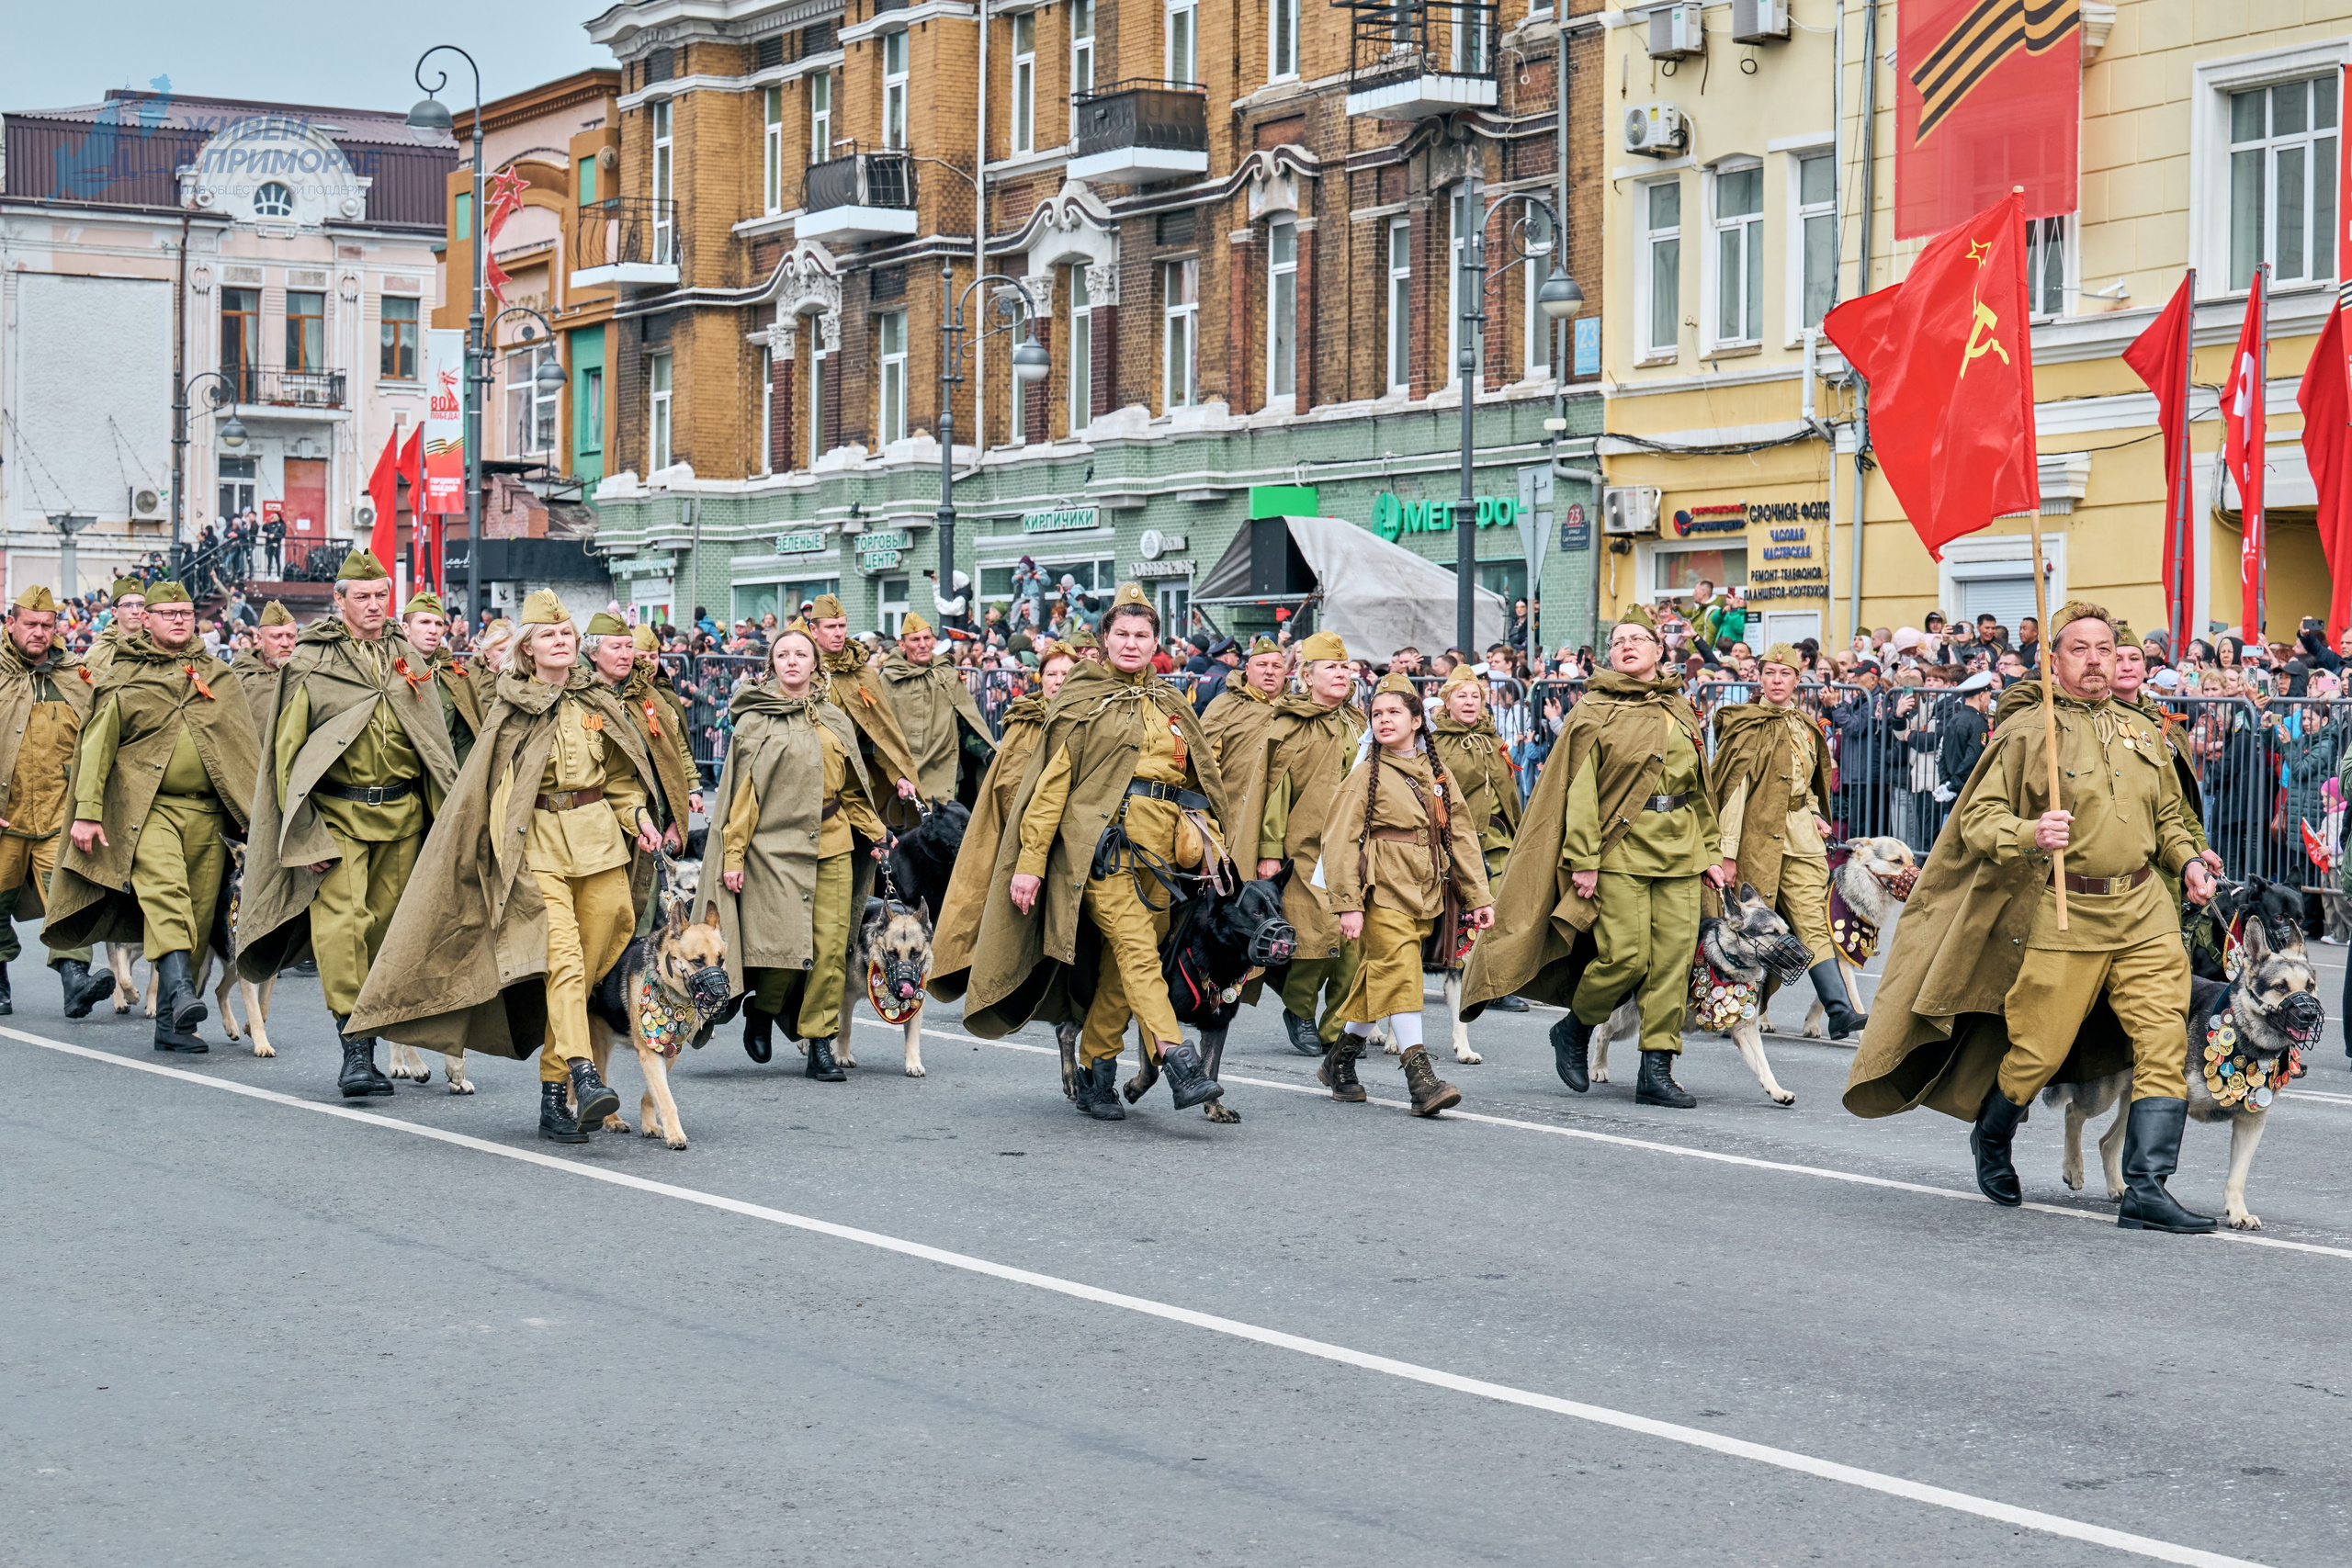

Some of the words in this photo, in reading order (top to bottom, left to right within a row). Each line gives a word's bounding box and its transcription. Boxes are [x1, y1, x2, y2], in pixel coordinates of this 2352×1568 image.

[1578, 321, 1598, 349] 23
[430, 395, 447, 411] 80
[430, 412, 460, 421] ПОБЕДА!
[1024, 510, 1093, 531] КИРПИЧИКИ
[1569, 508, 1581, 525] 23
[1749, 502, 1797, 523] СРОЧНОЕ
[1801, 501, 1830, 521] ФОТО
[776, 534, 820, 551] ЗЕЛЕНЫЕ
[1770, 527, 1804, 542] ЧАСОВАЯ
[865, 552, 897, 570] ЦЕНТР
[1763, 545, 1811, 560] МАСТЕРСКАЯ
[1751, 570, 1778, 581] РЕМОНТ
[1781, 567, 1822, 581] ТЕЛЕФОНОВ
[1744, 586, 1785, 601] ПЛАНШЕТОВ
[1788, 584, 1829, 598] НОУТБУКОВ
